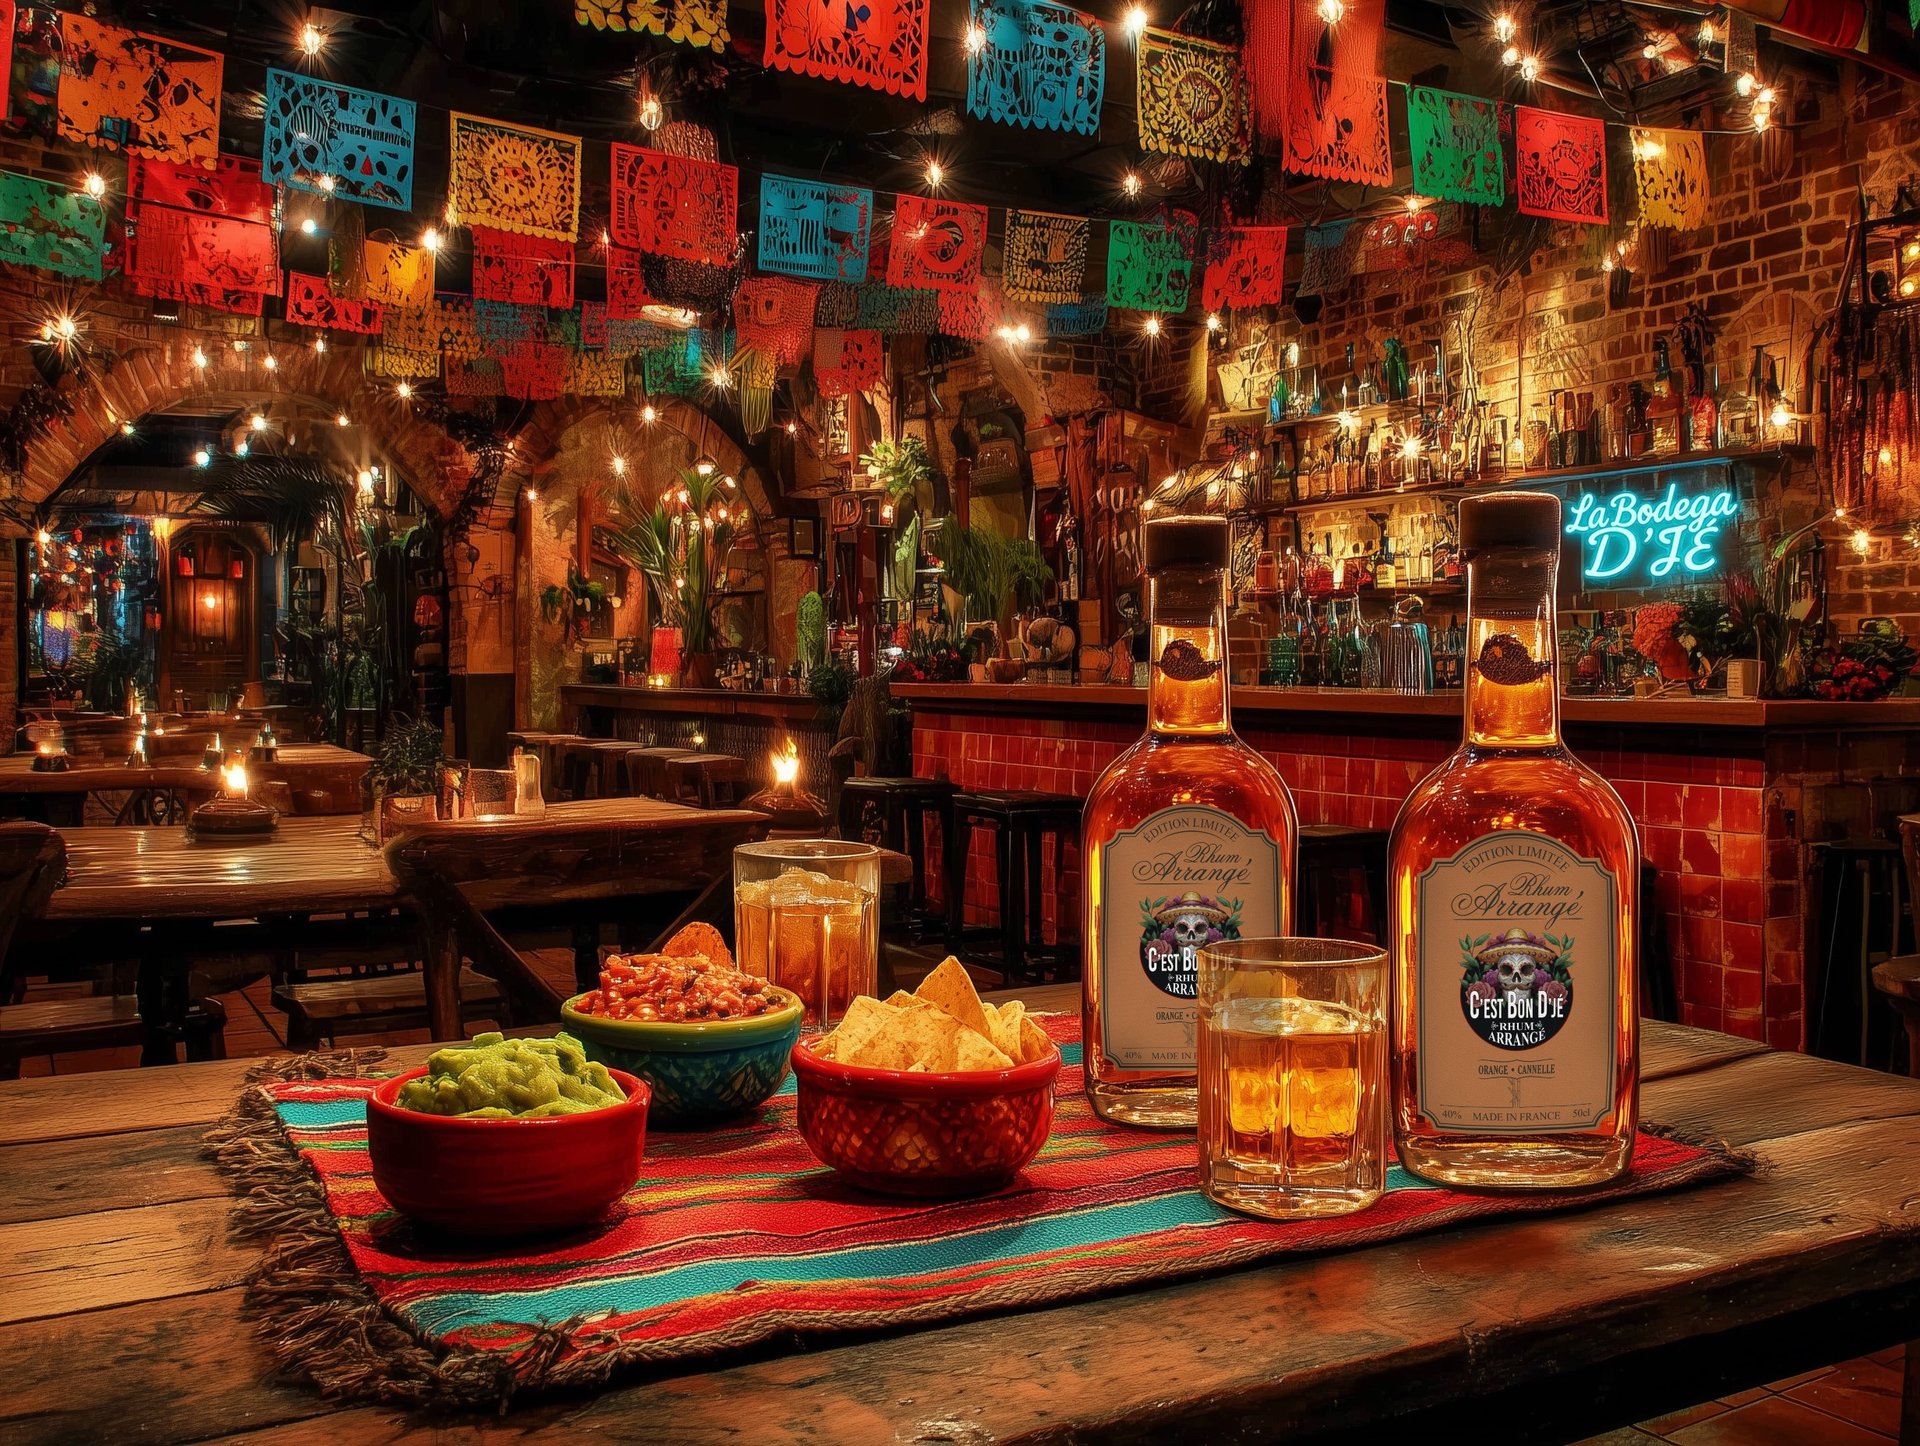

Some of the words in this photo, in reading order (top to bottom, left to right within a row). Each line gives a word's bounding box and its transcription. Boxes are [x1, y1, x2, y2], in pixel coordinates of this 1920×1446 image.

[1566, 493, 1610, 534] La
[1610, 483, 1738, 533] Bodega
[1192, 817, 1240, 843] LIMITÉE
[1183, 841, 1242, 864] Rhum
[1517, 844, 1571, 873] LIMITÉE
[1507, 871, 1573, 897] Rhum
[1155, 1011, 1184, 1021] ORANGE
[1499, 1021, 1535, 1031] RHUM
[1488, 1028, 1546, 1047] ARRANGÉ
[1124, 1051, 1142, 1060] 40%
[1151, 1052, 1179, 1060] MADE
[1181, 1052, 1192, 1060] IN
[1478, 1064, 1509, 1075] ORANGE
[1517, 1063, 1556, 1075] CANNELLE
[1442, 1110, 1463, 1120] 40%
[1472, 1111, 1504, 1122] MADE
[1506, 1111, 1519, 1121] IN
[1520, 1110, 1561, 1121] FRANCE
[1572, 1108, 1591, 1118] 50cl
